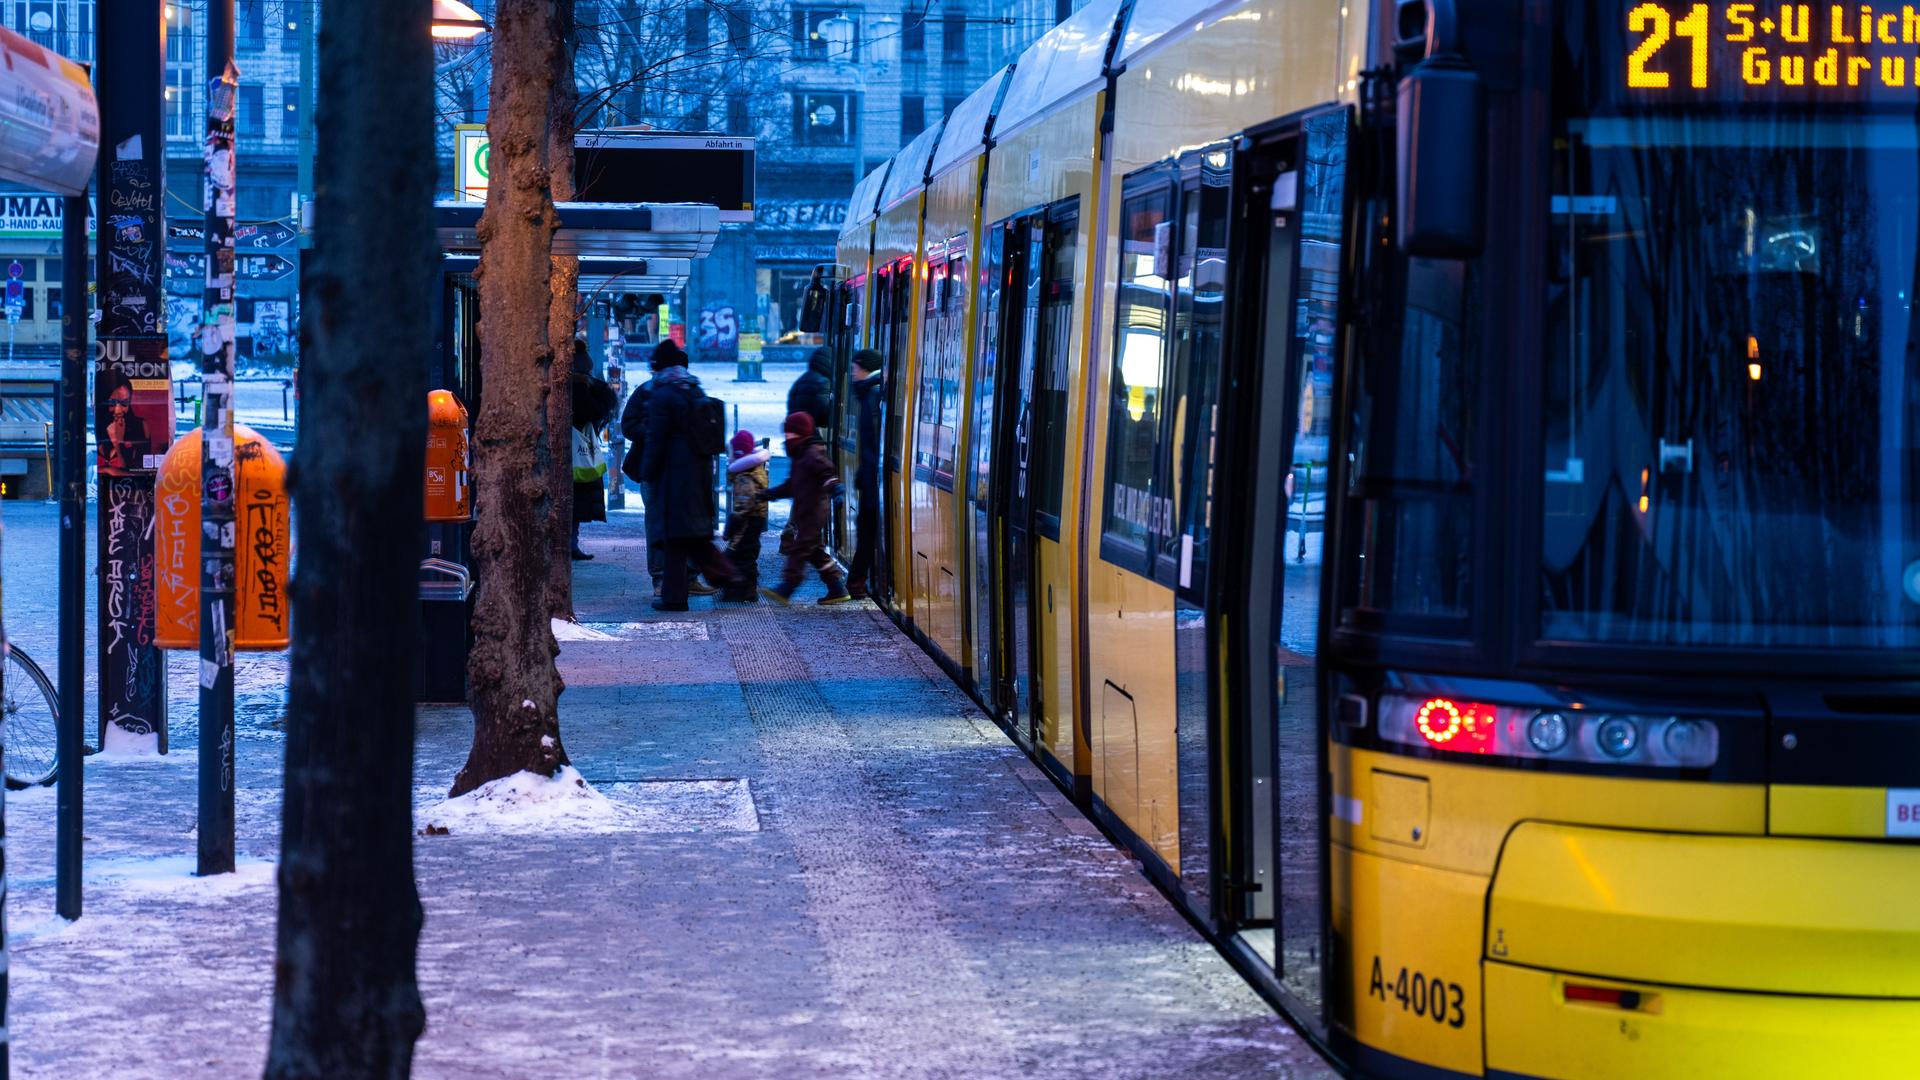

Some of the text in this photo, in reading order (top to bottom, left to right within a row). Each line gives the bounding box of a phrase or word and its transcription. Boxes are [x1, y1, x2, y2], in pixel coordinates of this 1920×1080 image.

[1726, 4, 1810, 43] S+U
[1628, 3, 1709, 88] 21
[1742, 46, 1920, 87] Gudru
[705, 140, 743, 149] Abfahrt in
[1370, 954, 1466, 1029] A-4003
